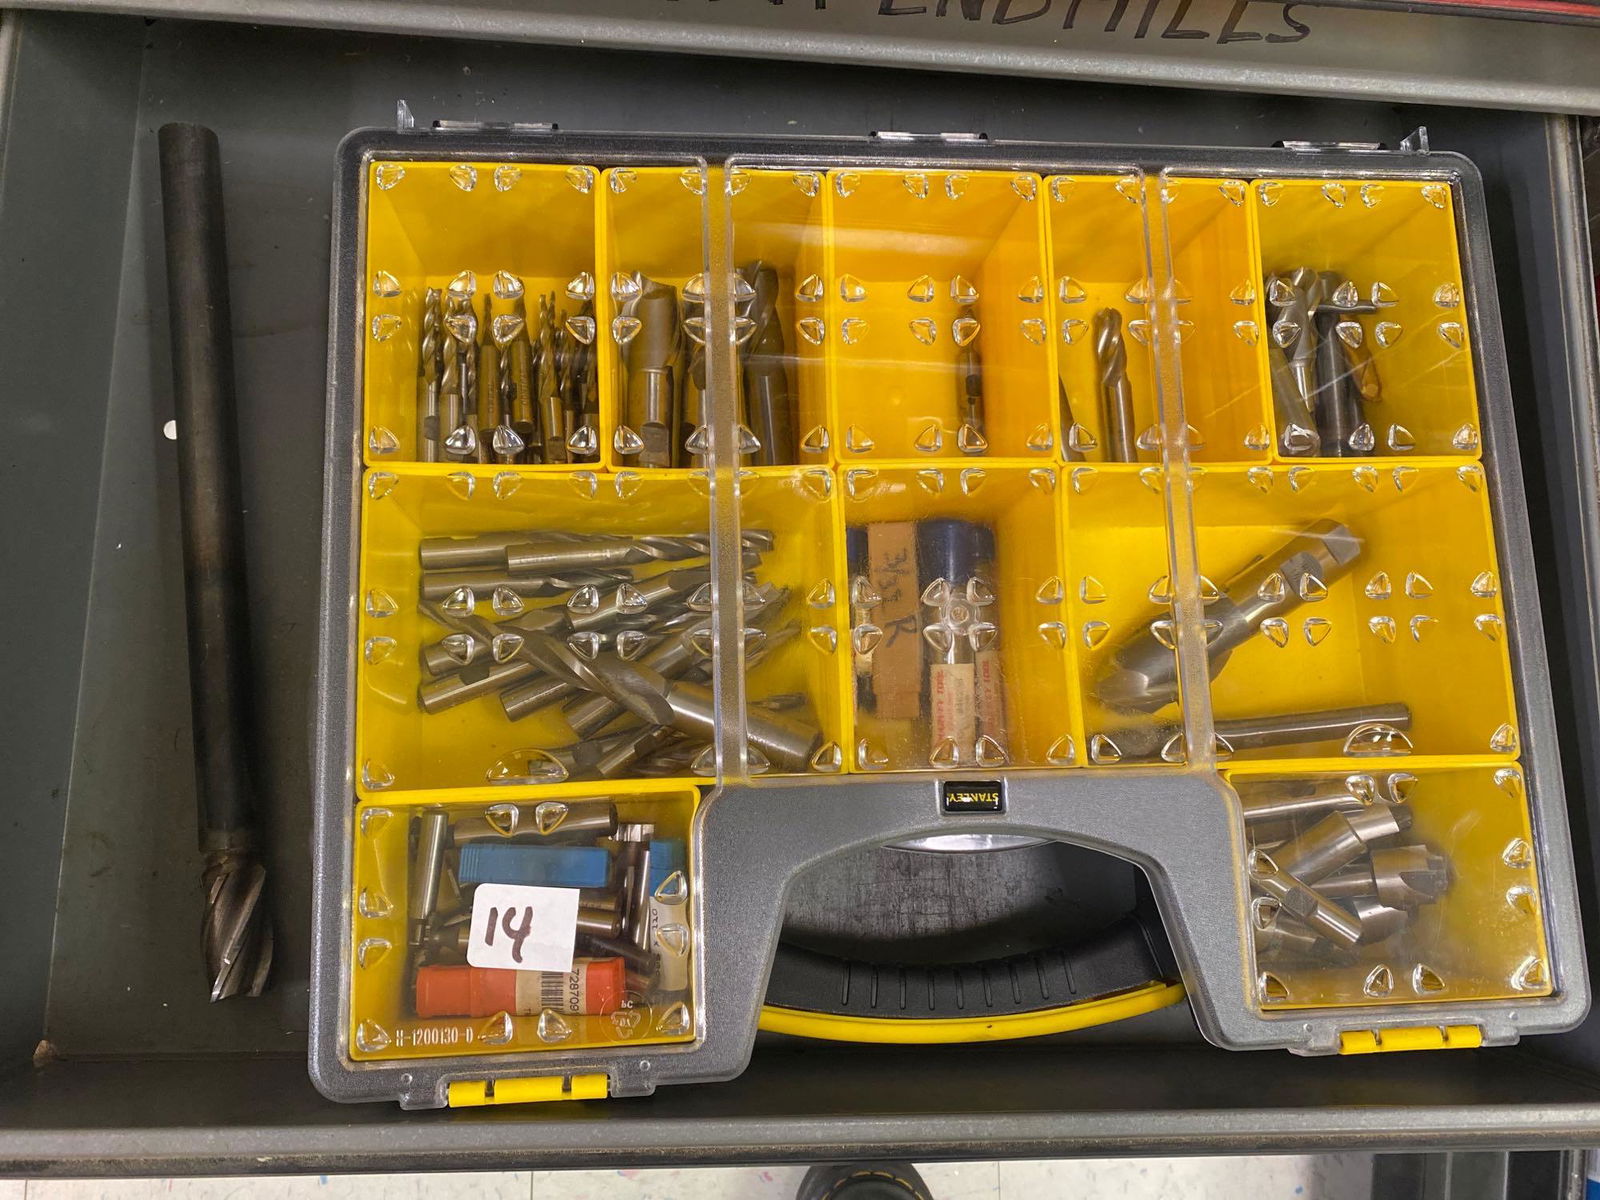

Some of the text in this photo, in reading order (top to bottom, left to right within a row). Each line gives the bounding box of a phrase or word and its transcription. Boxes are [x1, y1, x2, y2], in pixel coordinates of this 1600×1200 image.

[949, 792, 1000, 803] STANLEY
[485, 906, 533, 963] 14
[569, 968, 580, 1014] 728709
